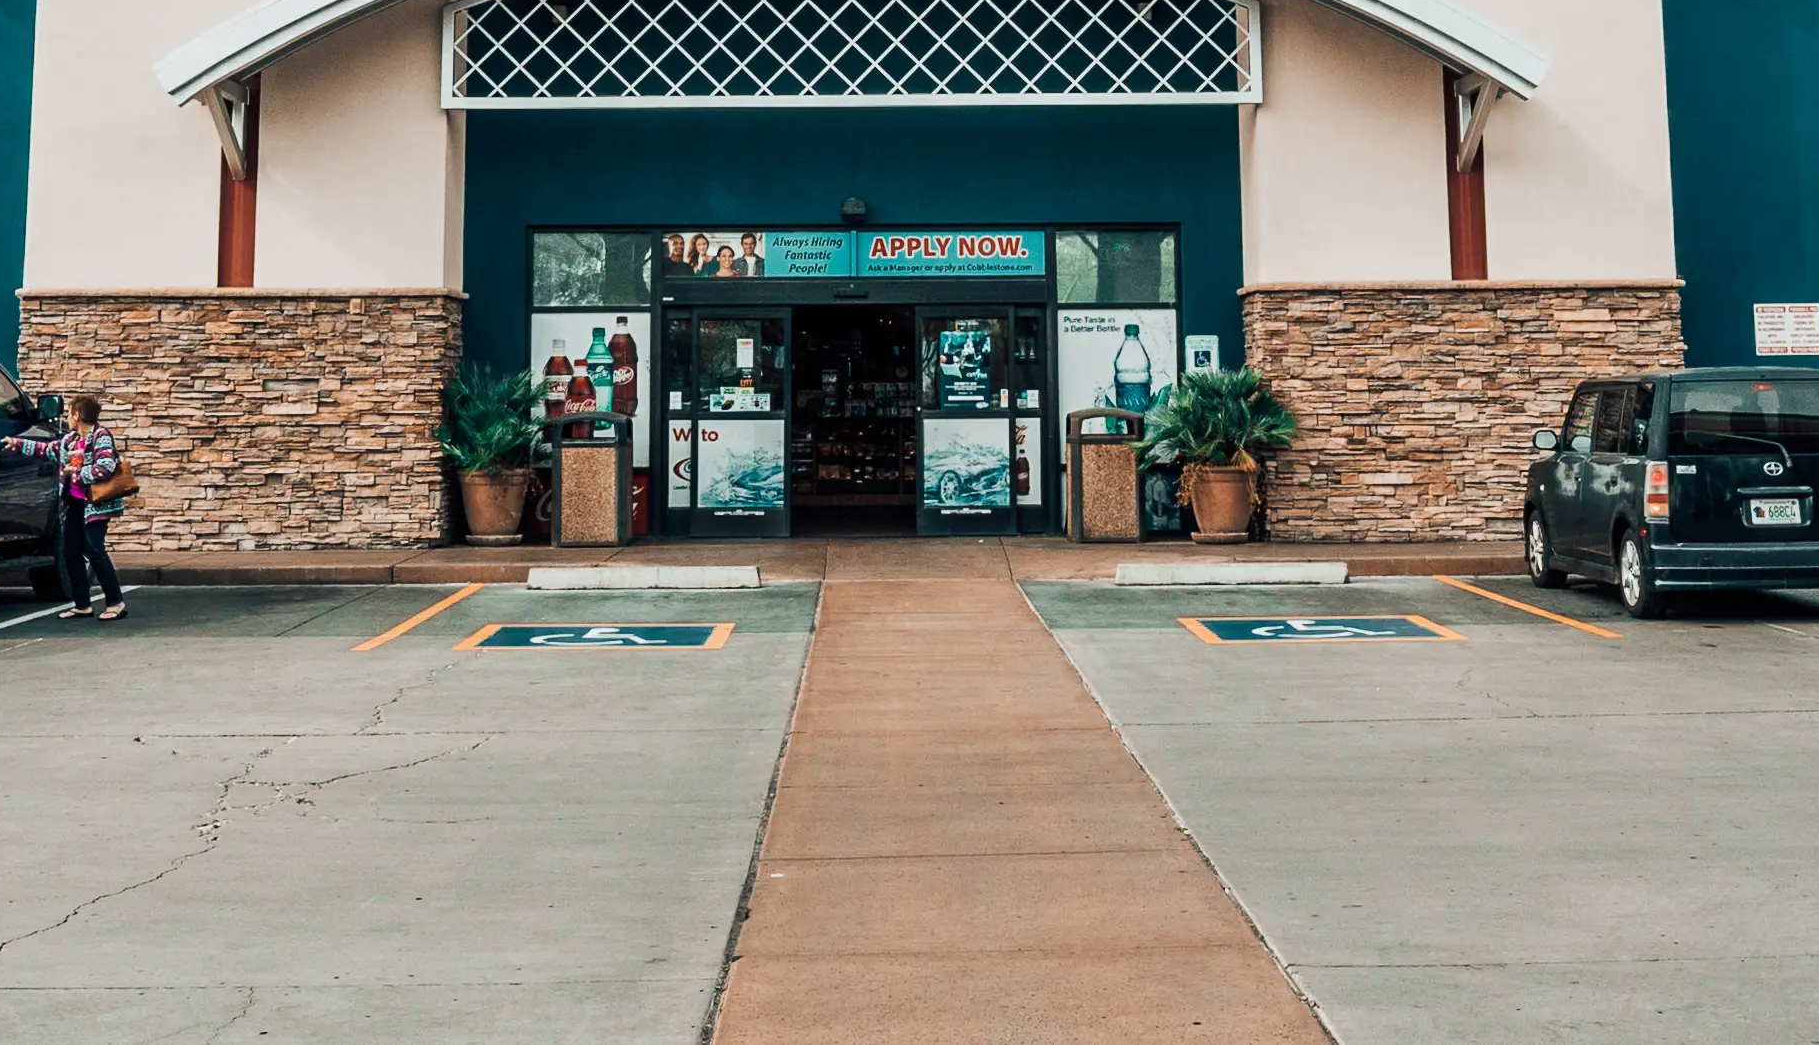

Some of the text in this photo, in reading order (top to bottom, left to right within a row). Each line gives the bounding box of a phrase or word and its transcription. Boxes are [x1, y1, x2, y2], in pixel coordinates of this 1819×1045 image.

[772, 236, 843, 249] Always Hiring
[870, 237, 1028, 257] APPLY NOW.
[784, 250, 832, 260] Fantastic
[788, 263, 828, 275] People!
[868, 264, 881, 272] Ask
[890, 264, 923, 274] Manager
[935, 264, 956, 273] apply
[1084, 316, 1106, 324] Taste
[701, 428, 719, 442] to
